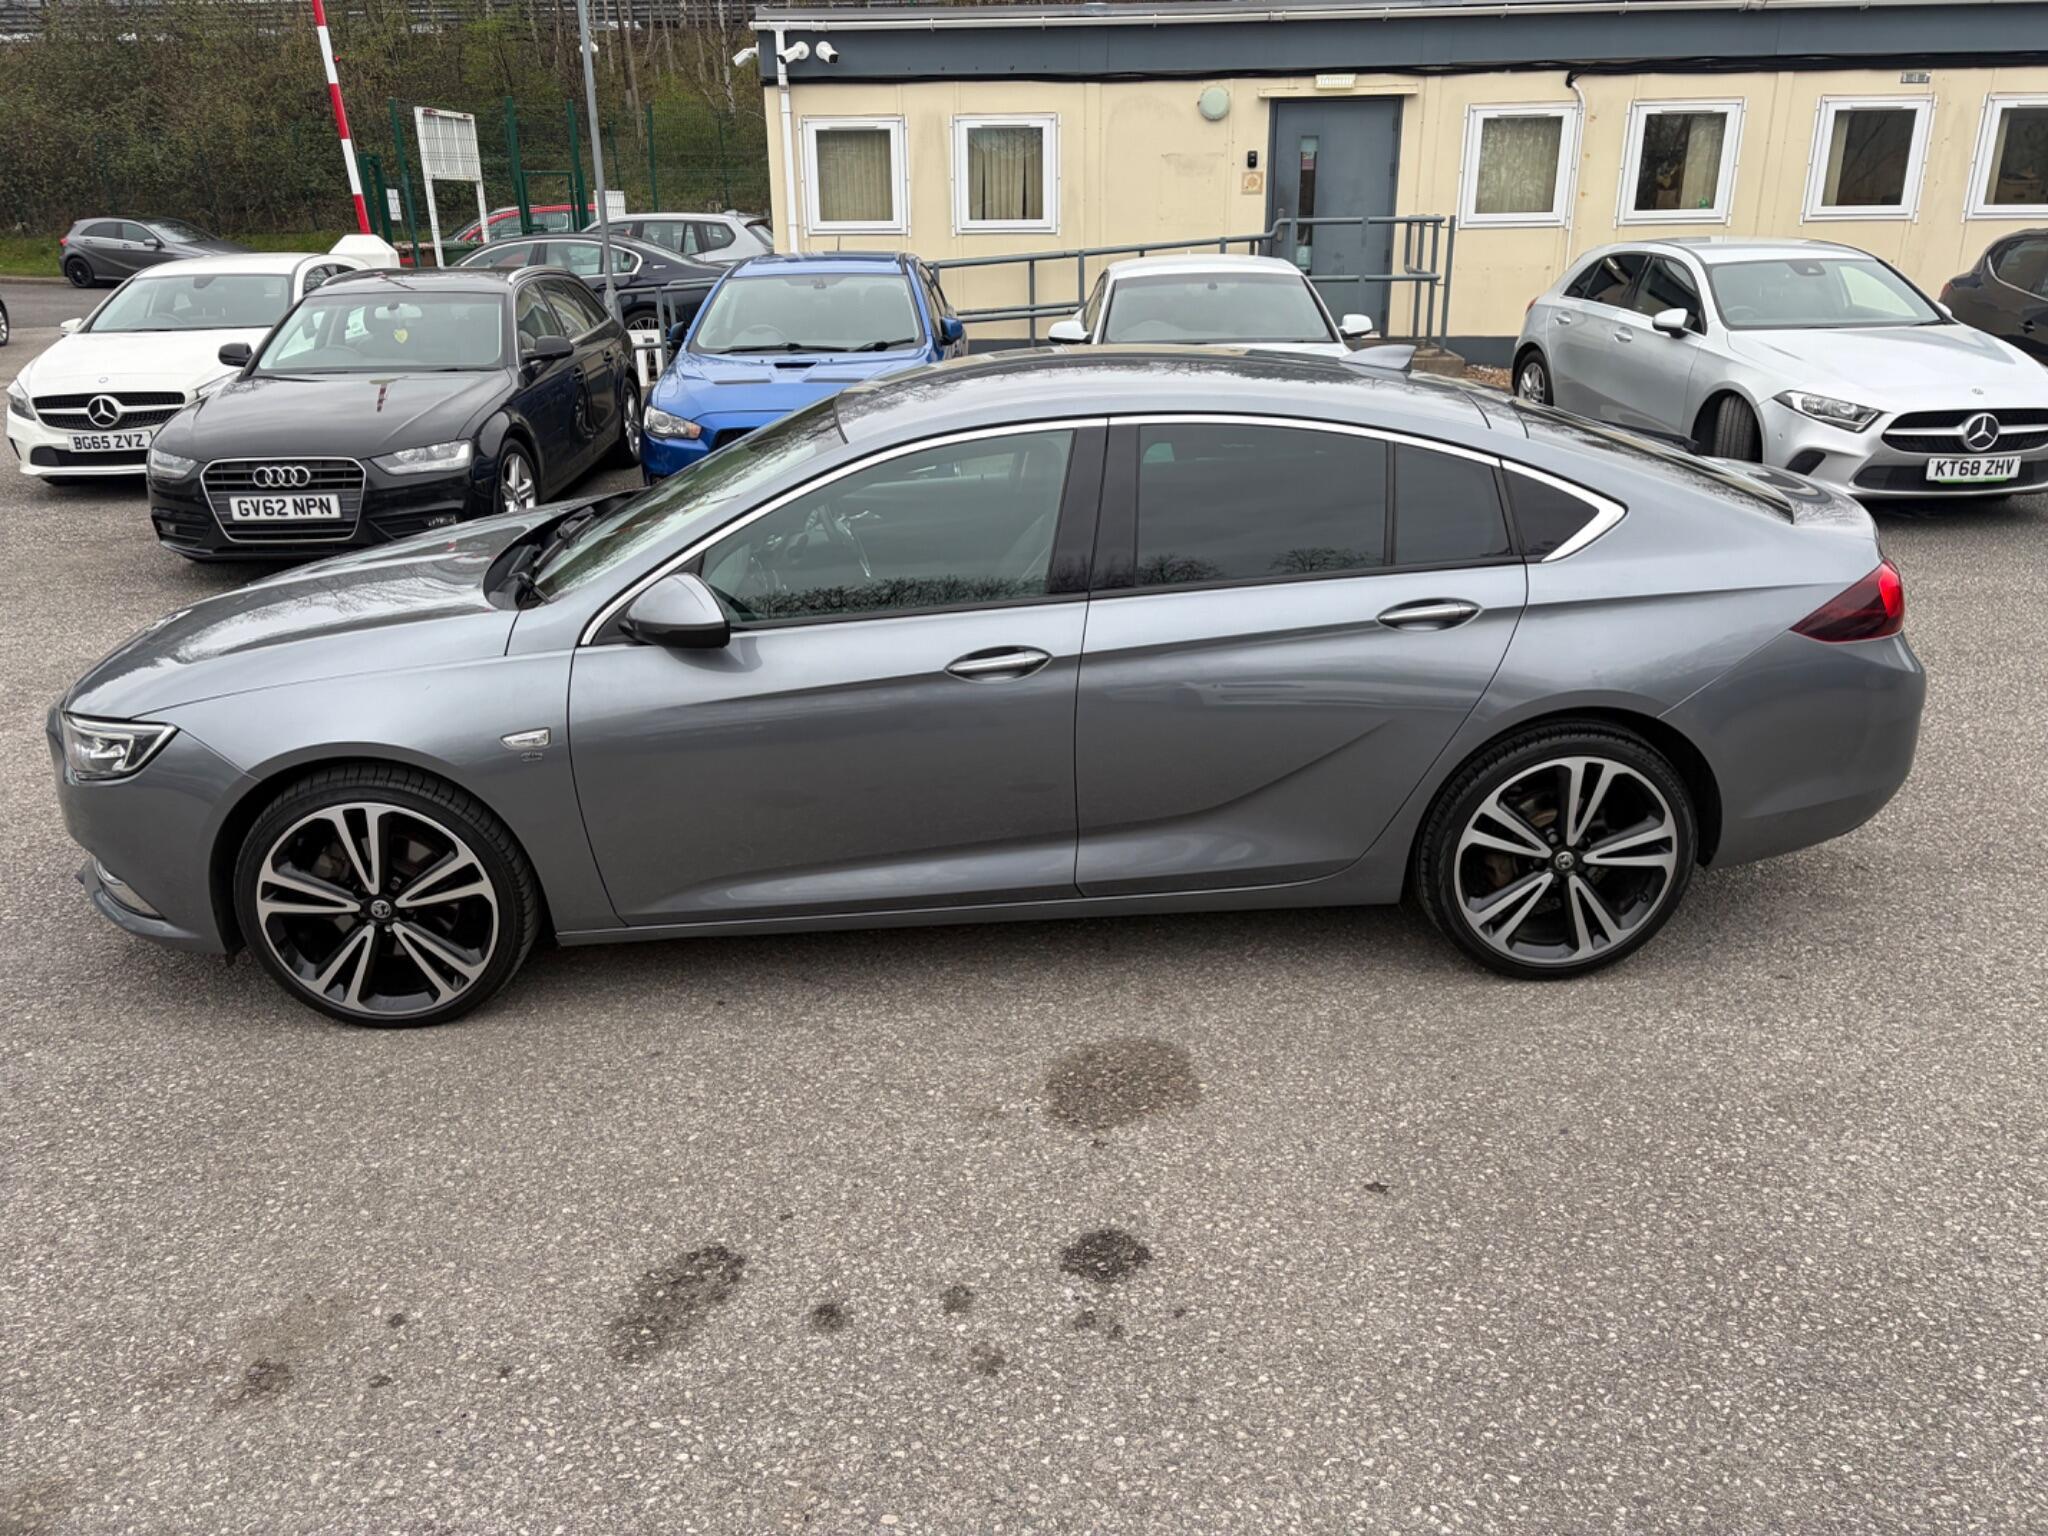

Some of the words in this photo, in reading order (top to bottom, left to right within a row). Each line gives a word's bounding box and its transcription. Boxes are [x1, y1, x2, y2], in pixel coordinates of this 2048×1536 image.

[73, 435, 111, 450] BG65
[113, 433, 145, 449] ZVZ
[1935, 460, 1981, 477] KT68
[1984, 458, 2015, 476] ZHV
[237, 498, 288, 517] GV62
[292, 497, 332, 515] NPN
